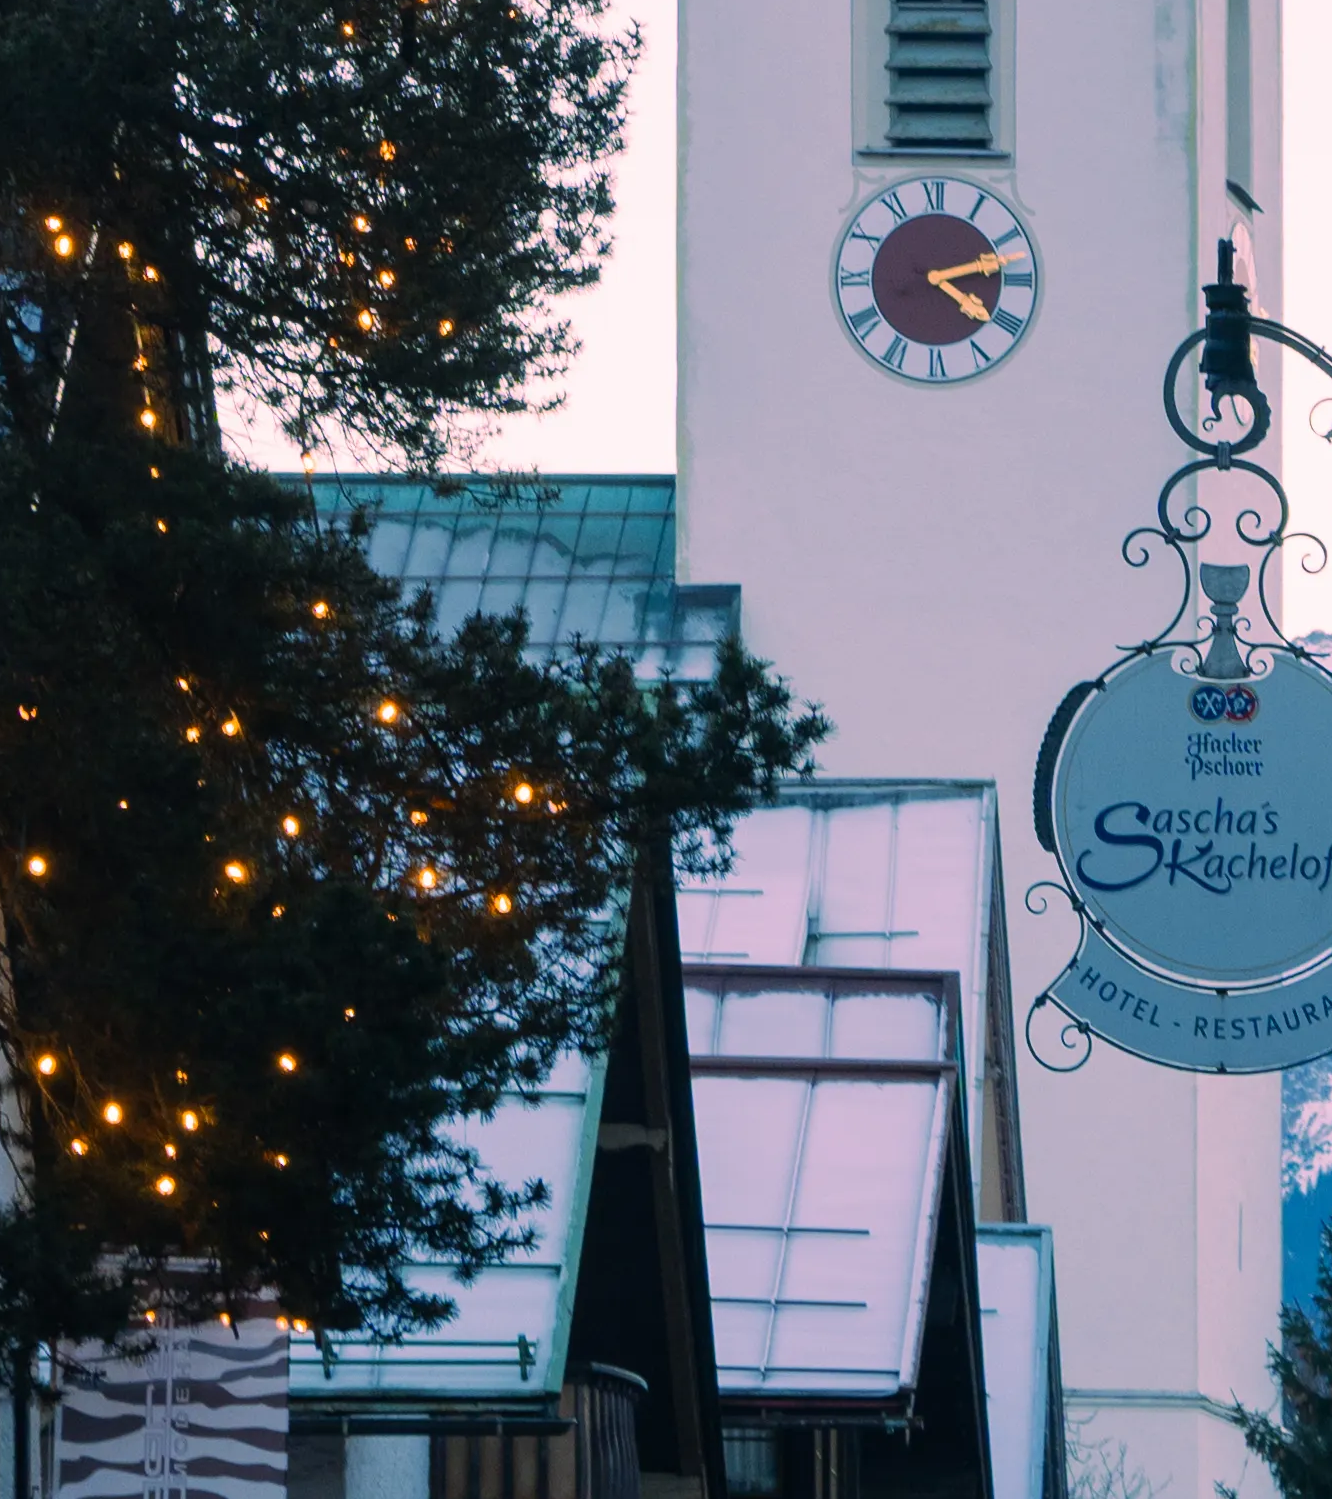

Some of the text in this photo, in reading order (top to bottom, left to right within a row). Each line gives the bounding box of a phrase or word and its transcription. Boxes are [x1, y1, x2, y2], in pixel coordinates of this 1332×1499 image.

[879, 190, 908, 226] XI
[921, 181, 948, 213] XII
[968, 192, 989, 222] I
[849, 222, 885, 253] X
[969, 339, 994, 371] V
[1187, 731, 1263, 757] Hacker
[1184, 754, 1264, 781] Pschorr
[1079, 967, 1162, 1029] HOTEL
